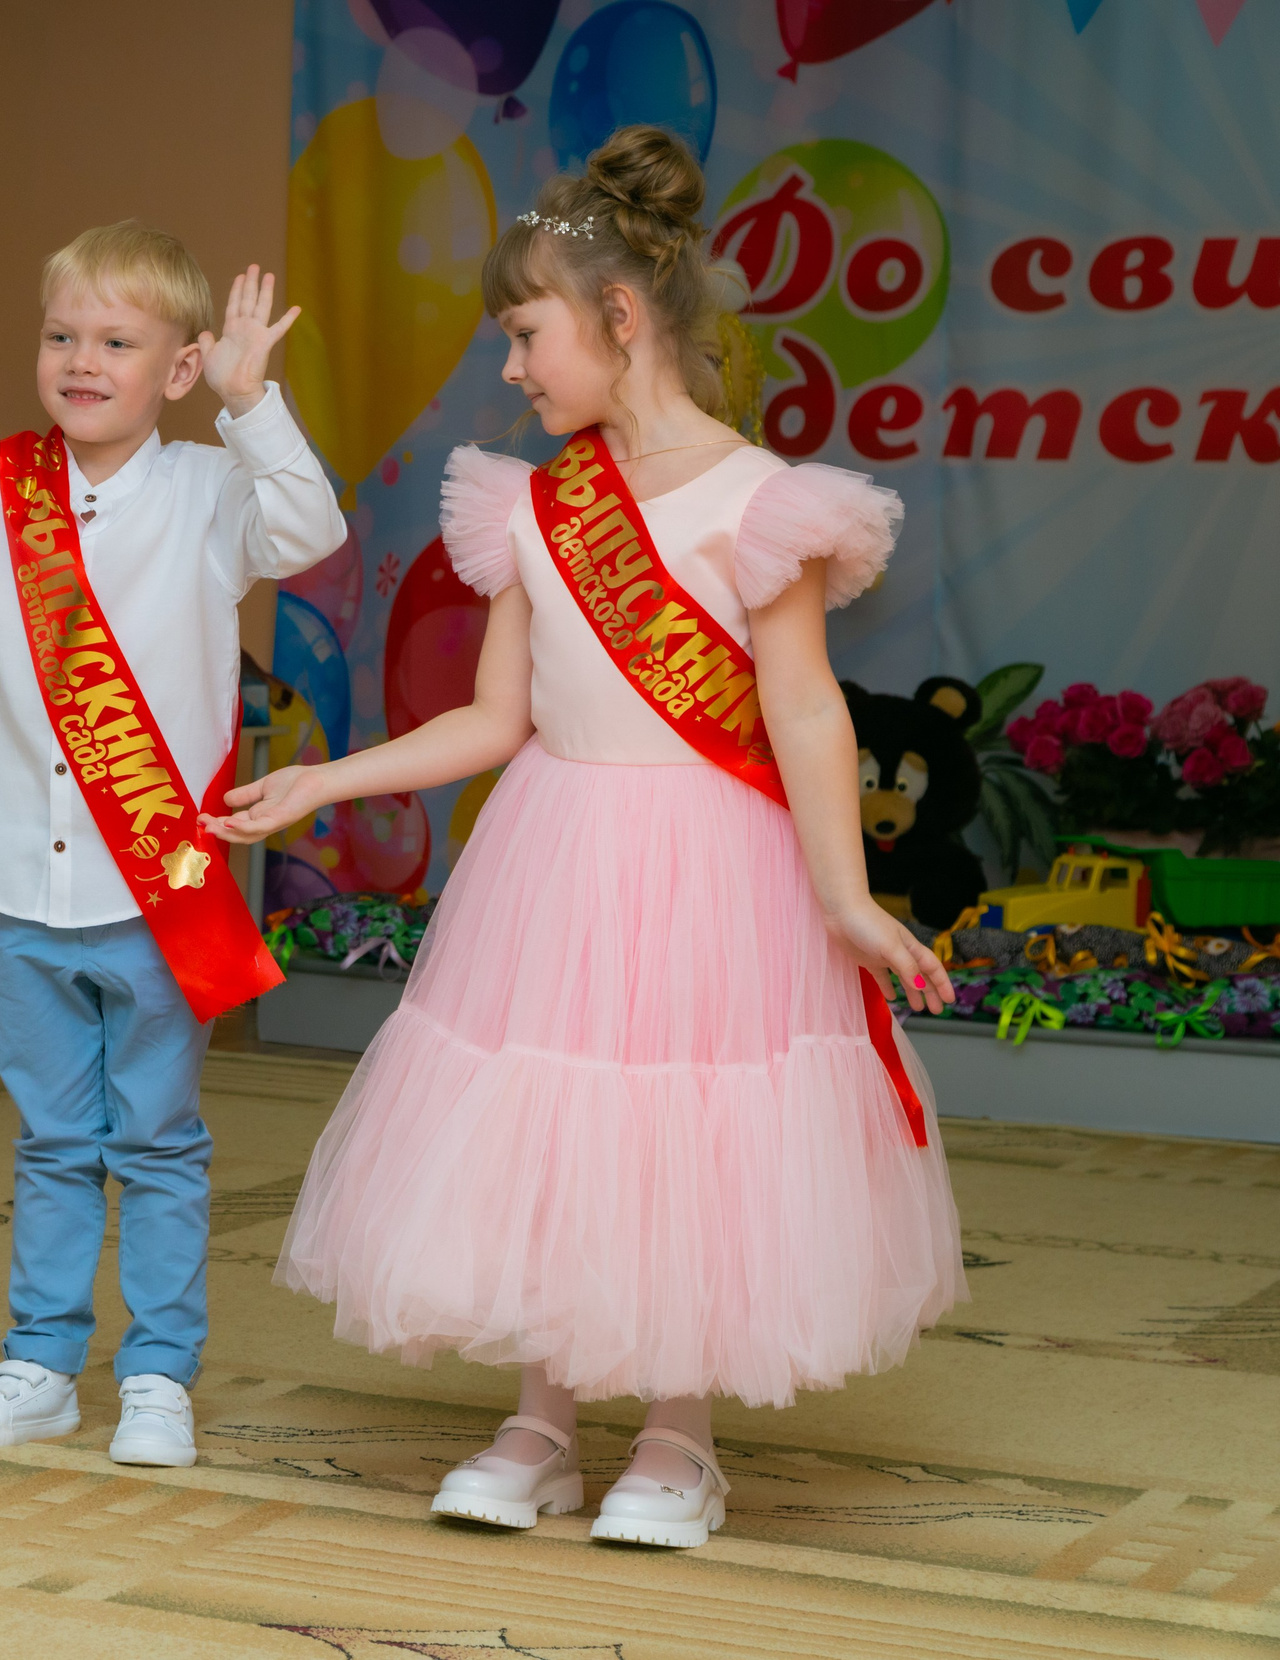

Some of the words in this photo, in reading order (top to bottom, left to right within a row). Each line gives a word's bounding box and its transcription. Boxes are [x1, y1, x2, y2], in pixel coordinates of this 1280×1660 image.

[710, 173, 924, 314] До
[989, 236, 1280, 311] сви
[763, 335, 1280, 464] детск
[17, 560, 73, 706] детского
[59, 713, 109, 785] сада
[21, 488, 184, 836] ВЫПУСКНИК
[547, 438, 762, 747] ВЫПУСКНИК
[550, 516, 634, 650] детского
[627, 652, 695, 720] сада
